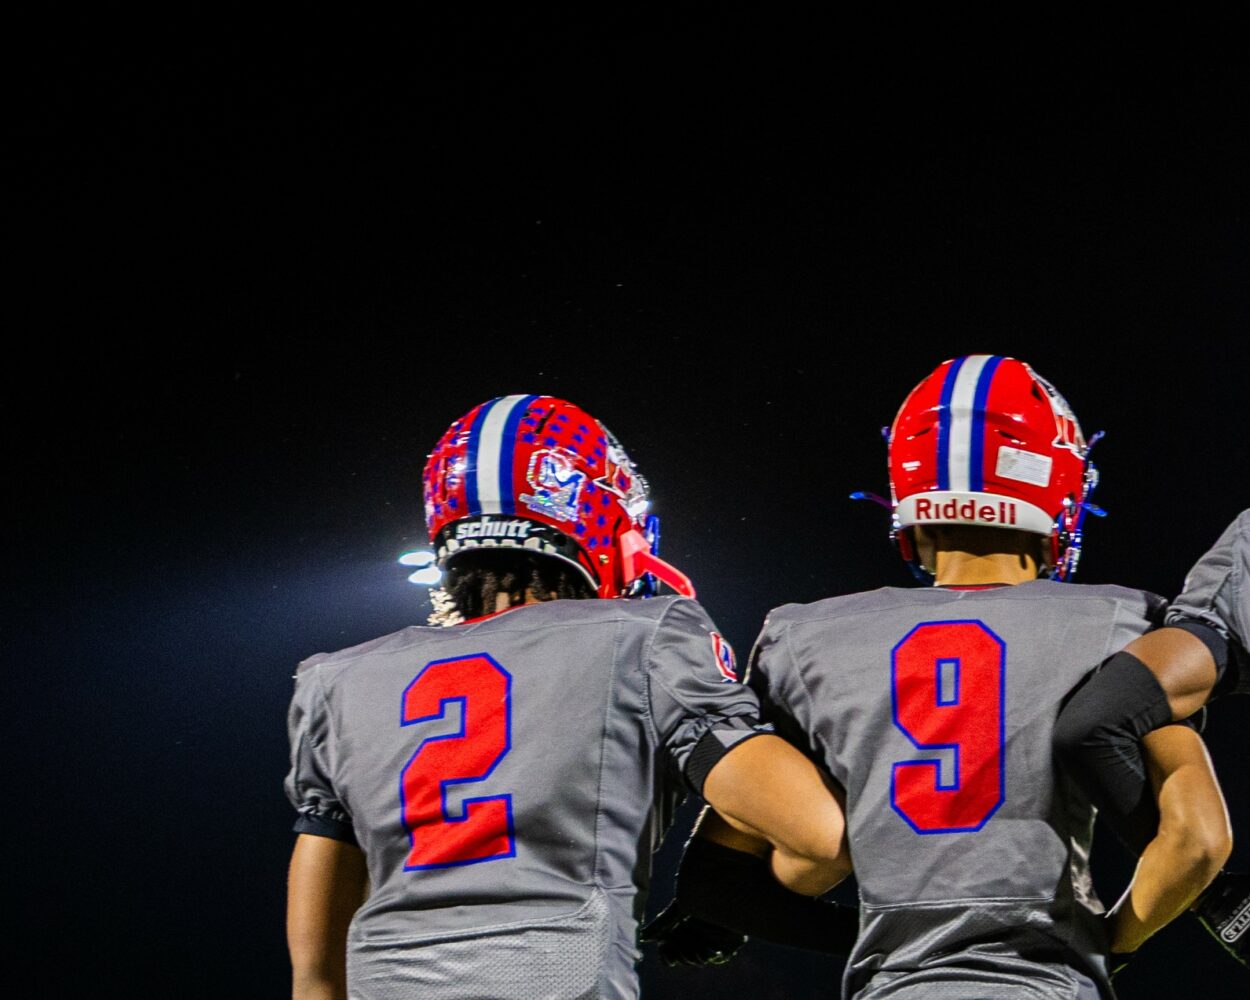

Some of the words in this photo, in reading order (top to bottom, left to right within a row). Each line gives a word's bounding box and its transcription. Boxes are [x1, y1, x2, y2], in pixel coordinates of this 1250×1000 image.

[455, 515, 532, 540] schutt
[915, 498, 1017, 526] Riddell
[398, 652, 517, 872] 2
[890, 619, 1007, 835] 9
